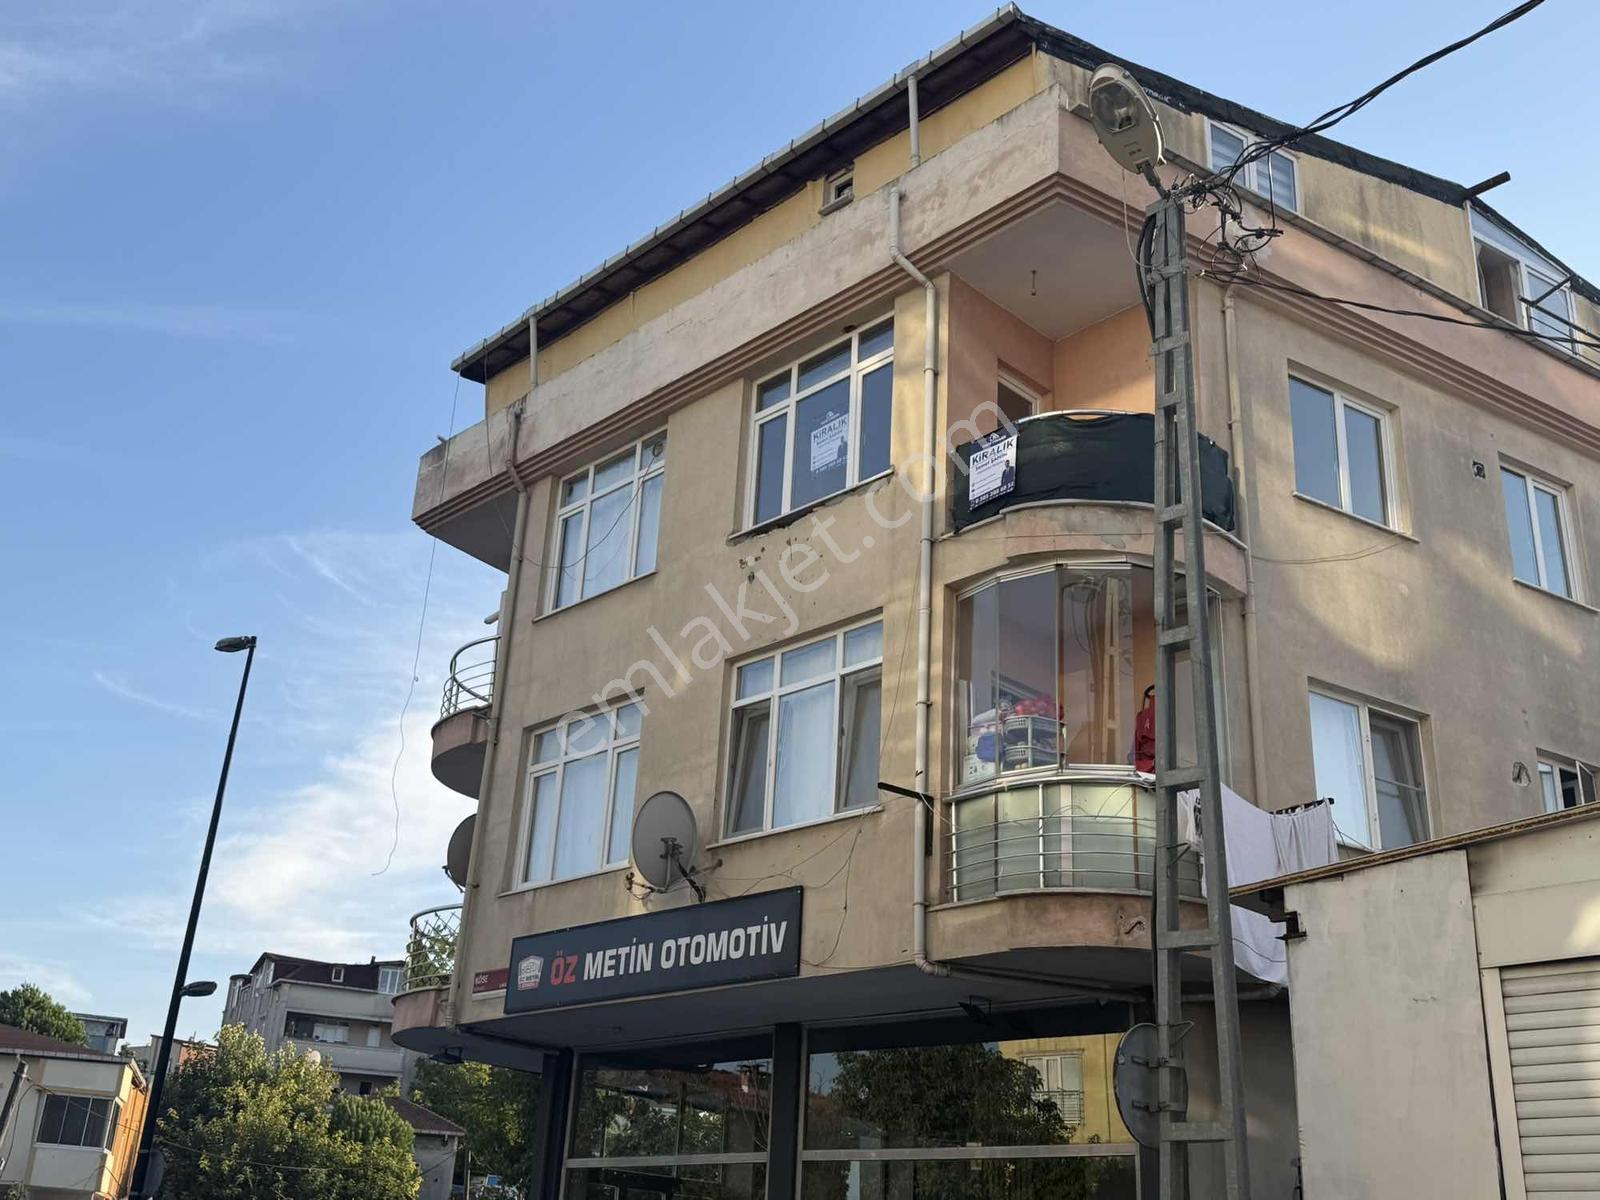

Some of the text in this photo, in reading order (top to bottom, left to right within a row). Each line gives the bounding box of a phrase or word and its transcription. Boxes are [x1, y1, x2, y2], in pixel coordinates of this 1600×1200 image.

[551, 916, 787, 985] ÖZ METİN OTOMOTİV
